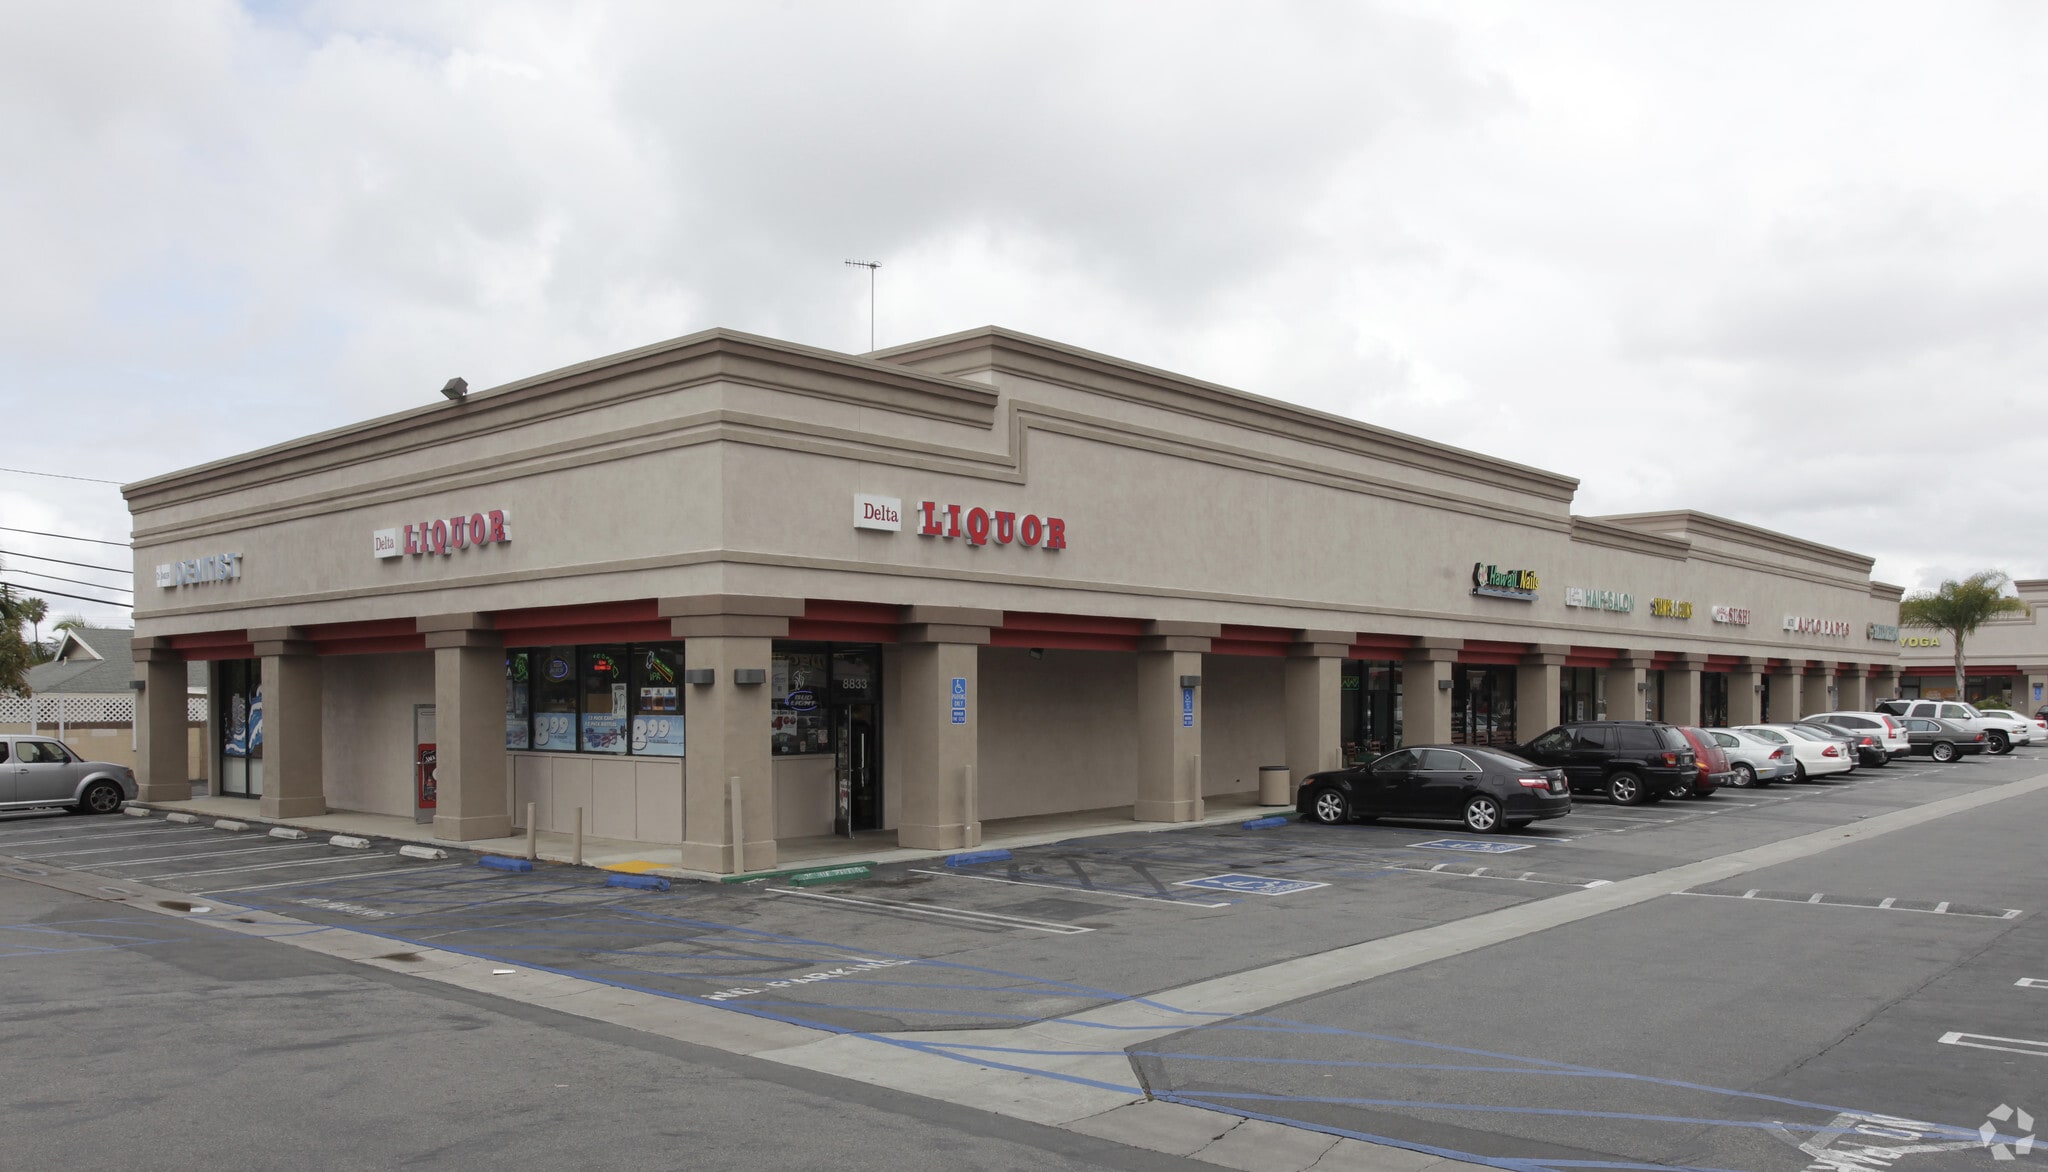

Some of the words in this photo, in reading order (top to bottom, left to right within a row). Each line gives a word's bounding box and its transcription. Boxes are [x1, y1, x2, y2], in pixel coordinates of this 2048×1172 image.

[375, 535, 395, 552] Delta
[404, 509, 509, 556] LIQUOR
[863, 502, 899, 523] Delta
[919, 501, 1067, 550] LIQUOR
[175, 553, 242, 586] DENTIST
[1490, 564, 1518, 588] Hawaii
[1520, 570, 1539, 590] Nails
[1607, 591, 1634, 612] SALON
[1728, 607, 1750, 624] SUSHI
[1799, 616, 1821, 635] AUTO
[1825, 620, 1850, 637] PARTS
[1900, 636, 1940, 648] YOGA
[842, 678, 868, 689] 8833
[701, 987, 762, 1001] NO
[766, 959, 917, 989] PARKING
